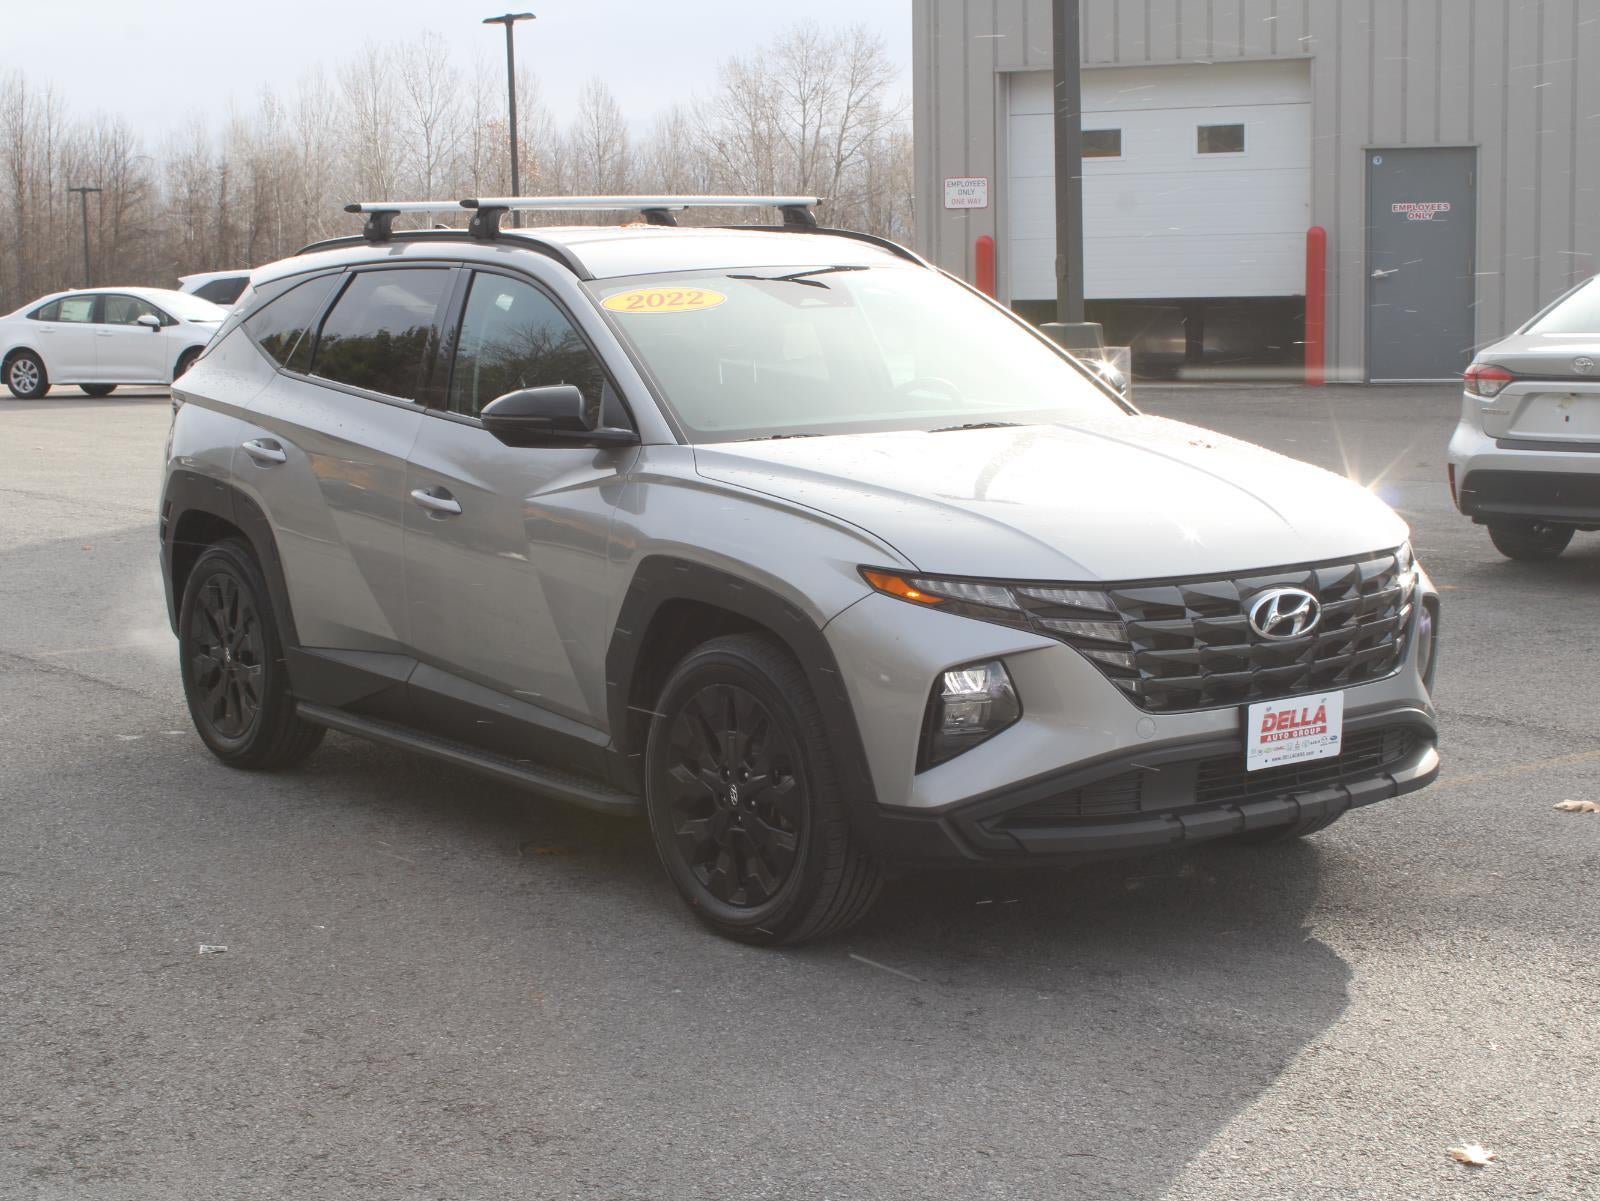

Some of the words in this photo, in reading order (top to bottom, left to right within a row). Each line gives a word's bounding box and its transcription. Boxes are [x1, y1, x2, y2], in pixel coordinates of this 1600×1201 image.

[946, 180, 986, 188] EMPLOYEES
[957, 188, 976, 196] ONLY
[1392, 202, 1450, 212] EMPLOYEES
[1407, 211, 1434, 220] ONLY
[626, 290, 705, 310] 2022
[1260, 704, 1327, 734] DELLA
[1266, 732, 1290, 743] AUTO
[1292, 727, 1321, 738] GROUP
